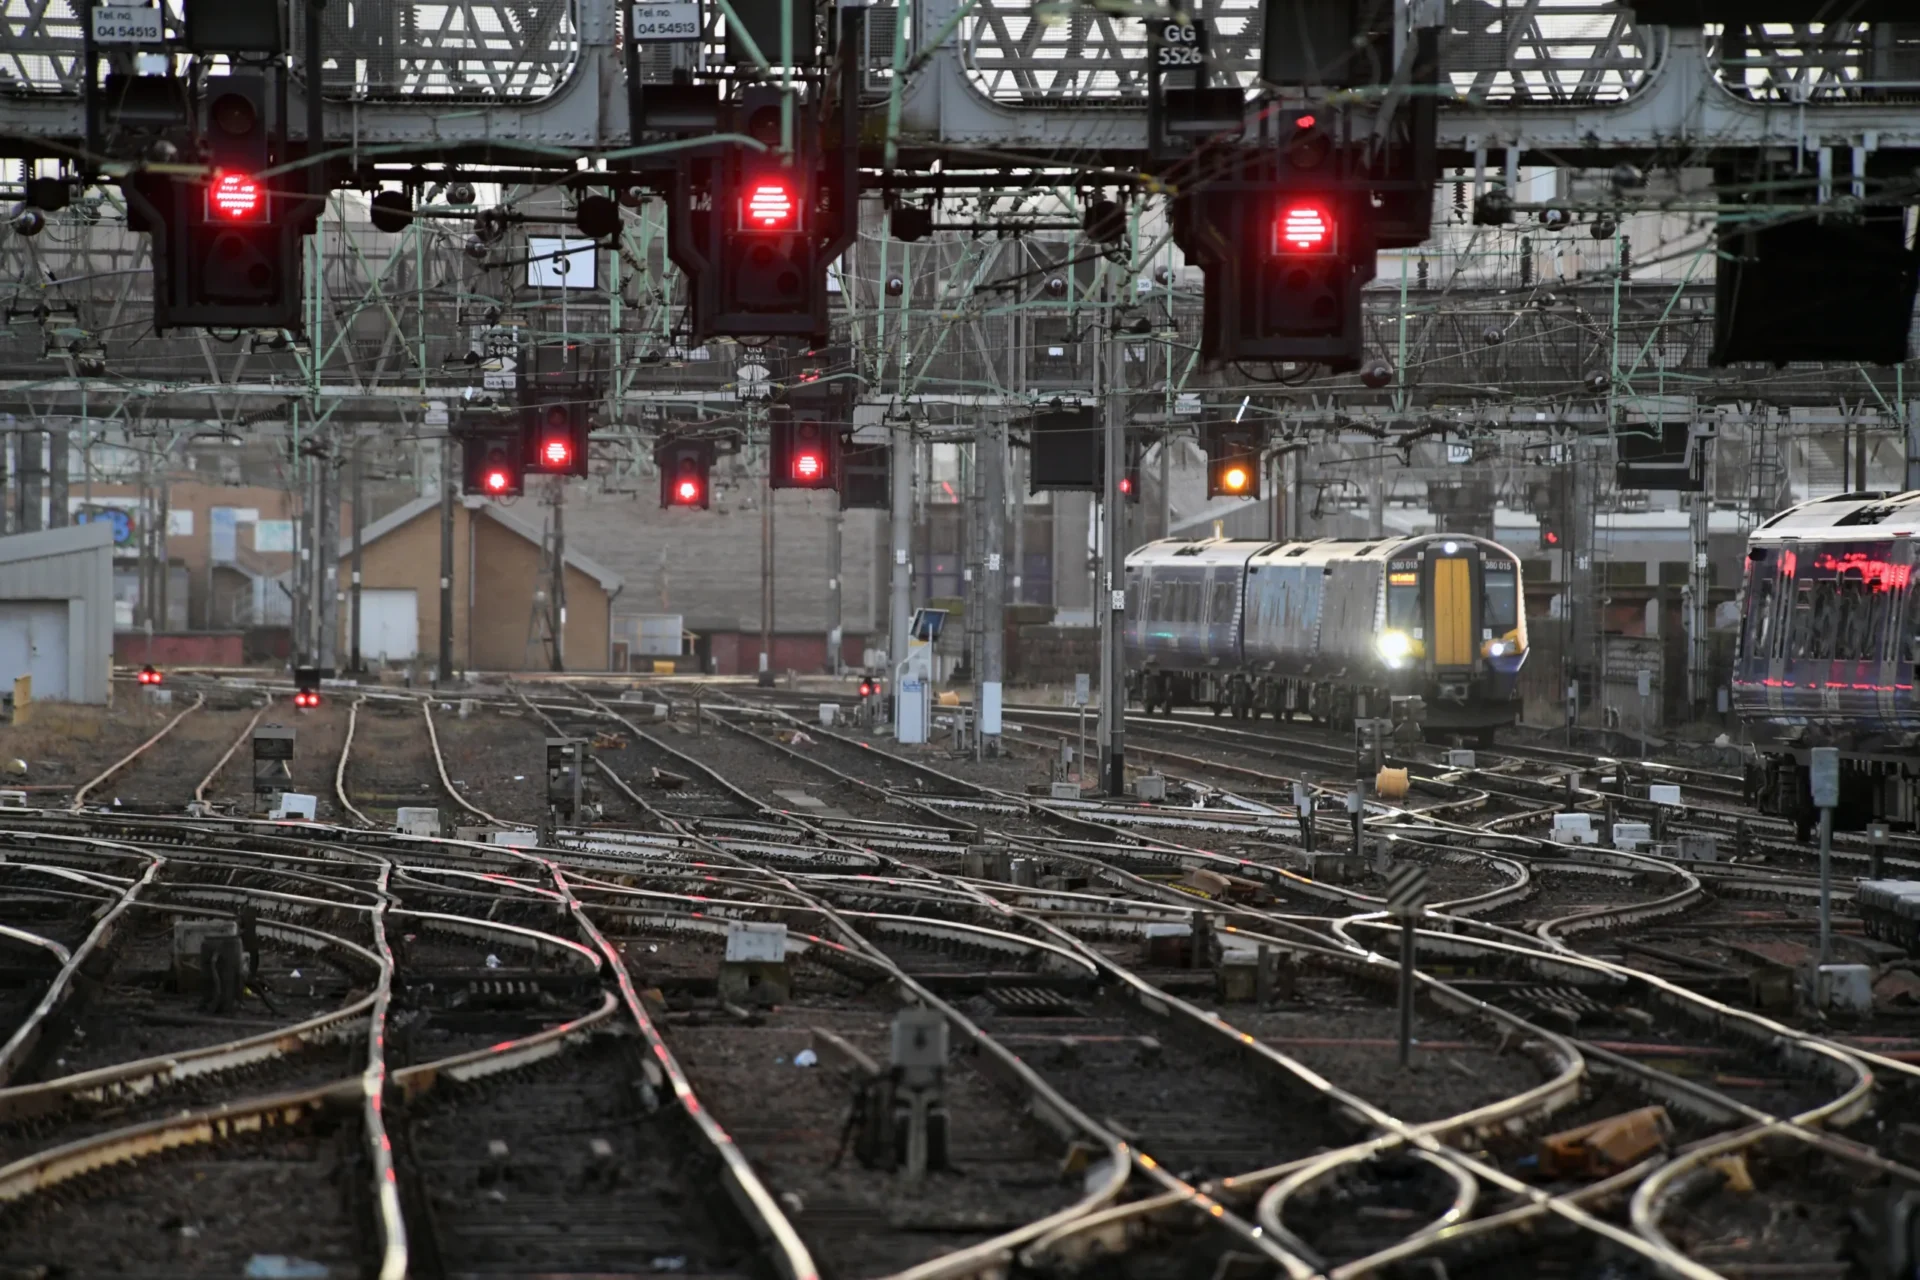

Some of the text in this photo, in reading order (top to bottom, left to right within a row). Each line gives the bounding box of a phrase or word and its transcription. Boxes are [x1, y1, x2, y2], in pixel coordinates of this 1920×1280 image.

[98, 26, 157, 38] 04 54513
[638, 22, 696, 34] 04 54513
[1164, 24, 1197, 42] GG
[1158, 46, 1203, 65] 5526
[552, 251, 571, 276] 5
[1392, 561, 1418, 570] 380 015
[1485, 561, 1511, 571] 380 015
